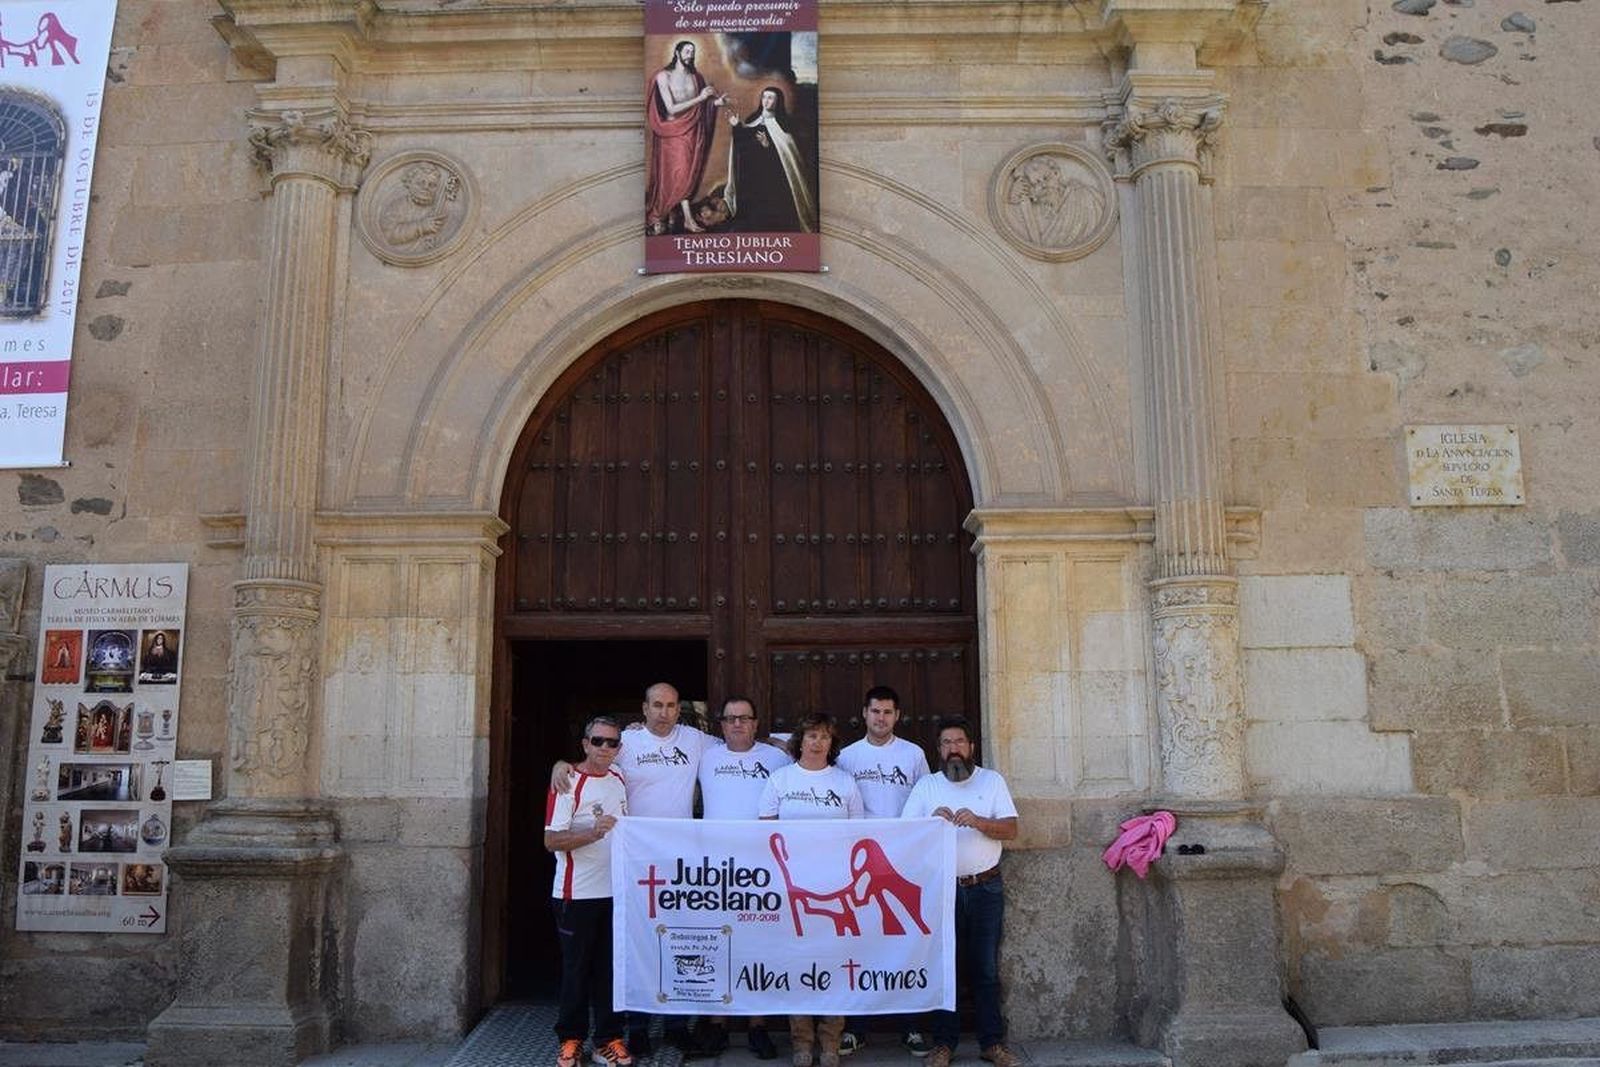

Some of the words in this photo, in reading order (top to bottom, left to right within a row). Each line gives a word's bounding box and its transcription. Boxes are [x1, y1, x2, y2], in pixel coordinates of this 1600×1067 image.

[706, 1, 742, 16] puedo
[744, 0, 800, 15] presumir
[675, 16, 690, 28] de
[692, 19, 708, 28] su
[86, 92, 98, 107] 15
[82, 117, 95, 140] DE
[69, 148, 90, 236] OCTUBRE
[674, 237, 731, 249] TEMPLO
[736, 236, 792, 249] JUBILAR
[65, 246, 79, 270] DE
[682, 250, 784, 265] TERESIANO
[60, 280, 75, 316] 2017
[17, 403, 57, 418] Teresa
[1440, 433, 1487, 444] IGLESIA
[671, 856, 771, 888] Jubileo
[122, 917, 135, 926] 60
[737, 913, 780, 922] 2017-2018
[736, 962, 790, 992] Alba
[800, 962, 831, 992] de
